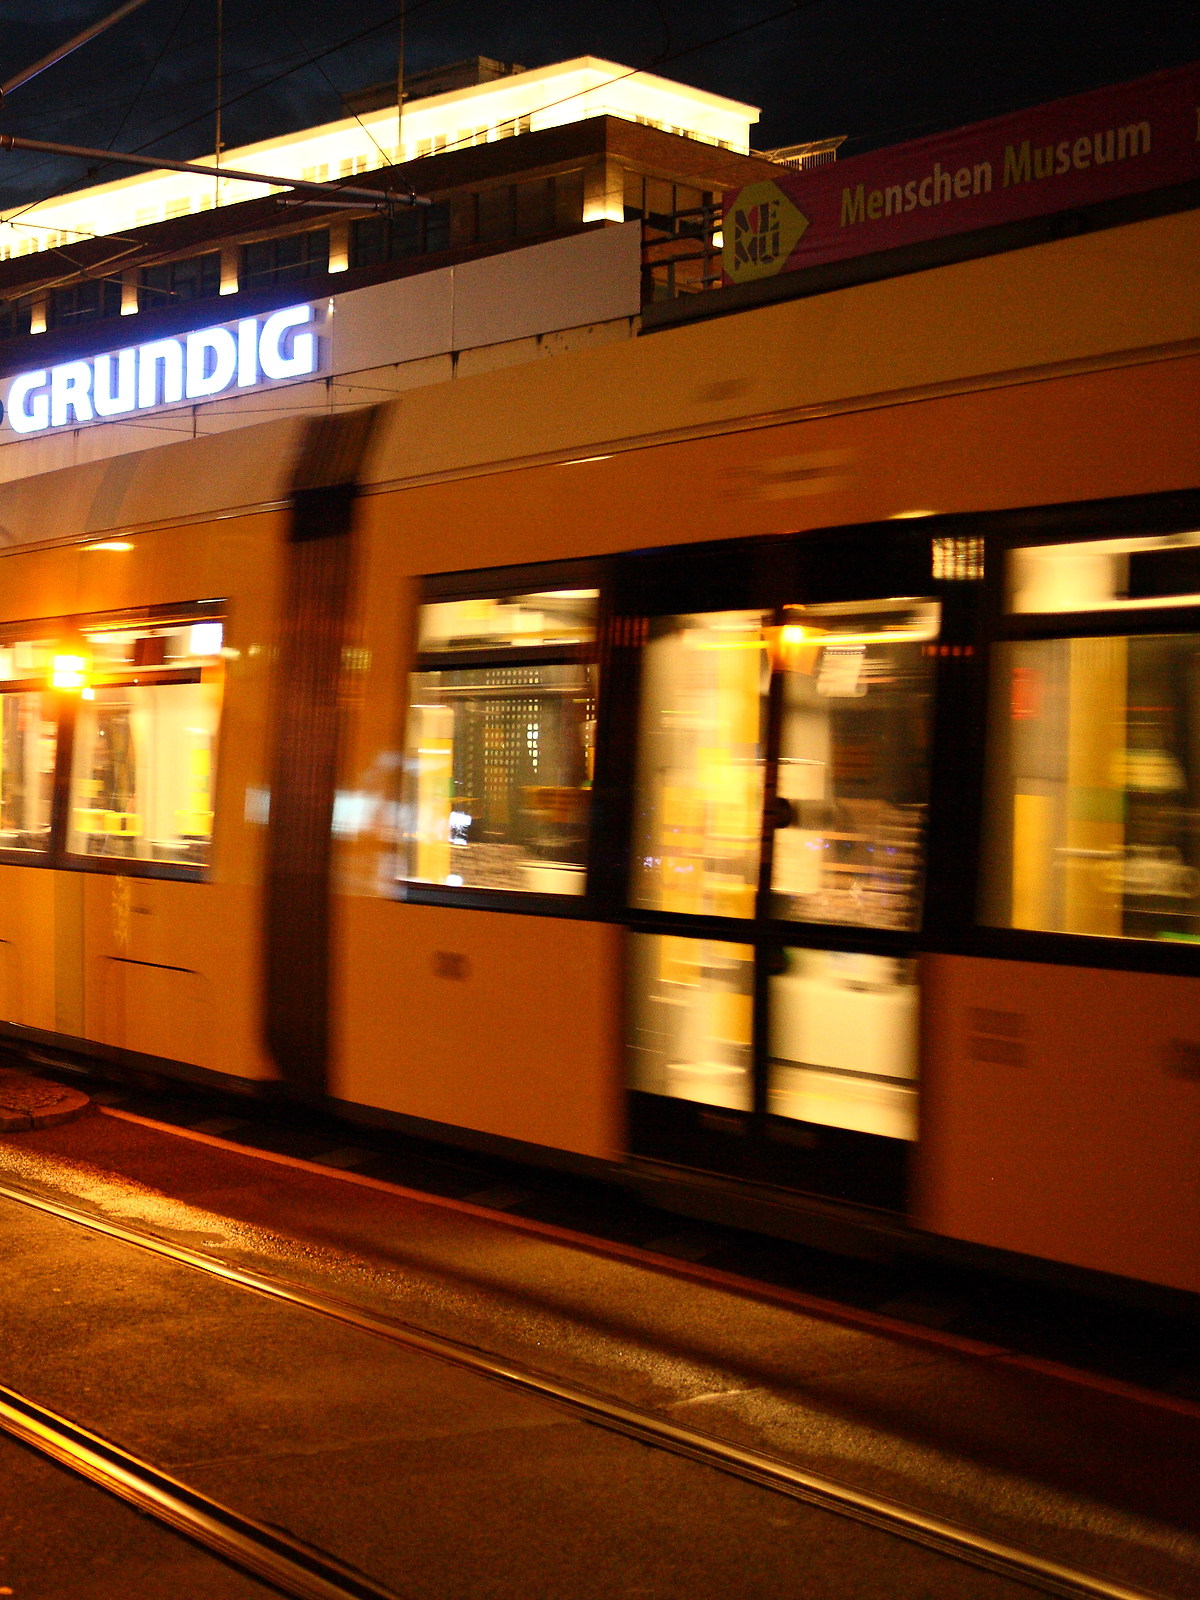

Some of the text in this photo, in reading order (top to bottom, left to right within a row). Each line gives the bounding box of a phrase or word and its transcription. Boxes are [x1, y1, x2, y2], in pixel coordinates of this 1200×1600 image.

[839, 120, 1152, 228] Menschen Museum
[7, 304, 317, 435] GRUNDIG
